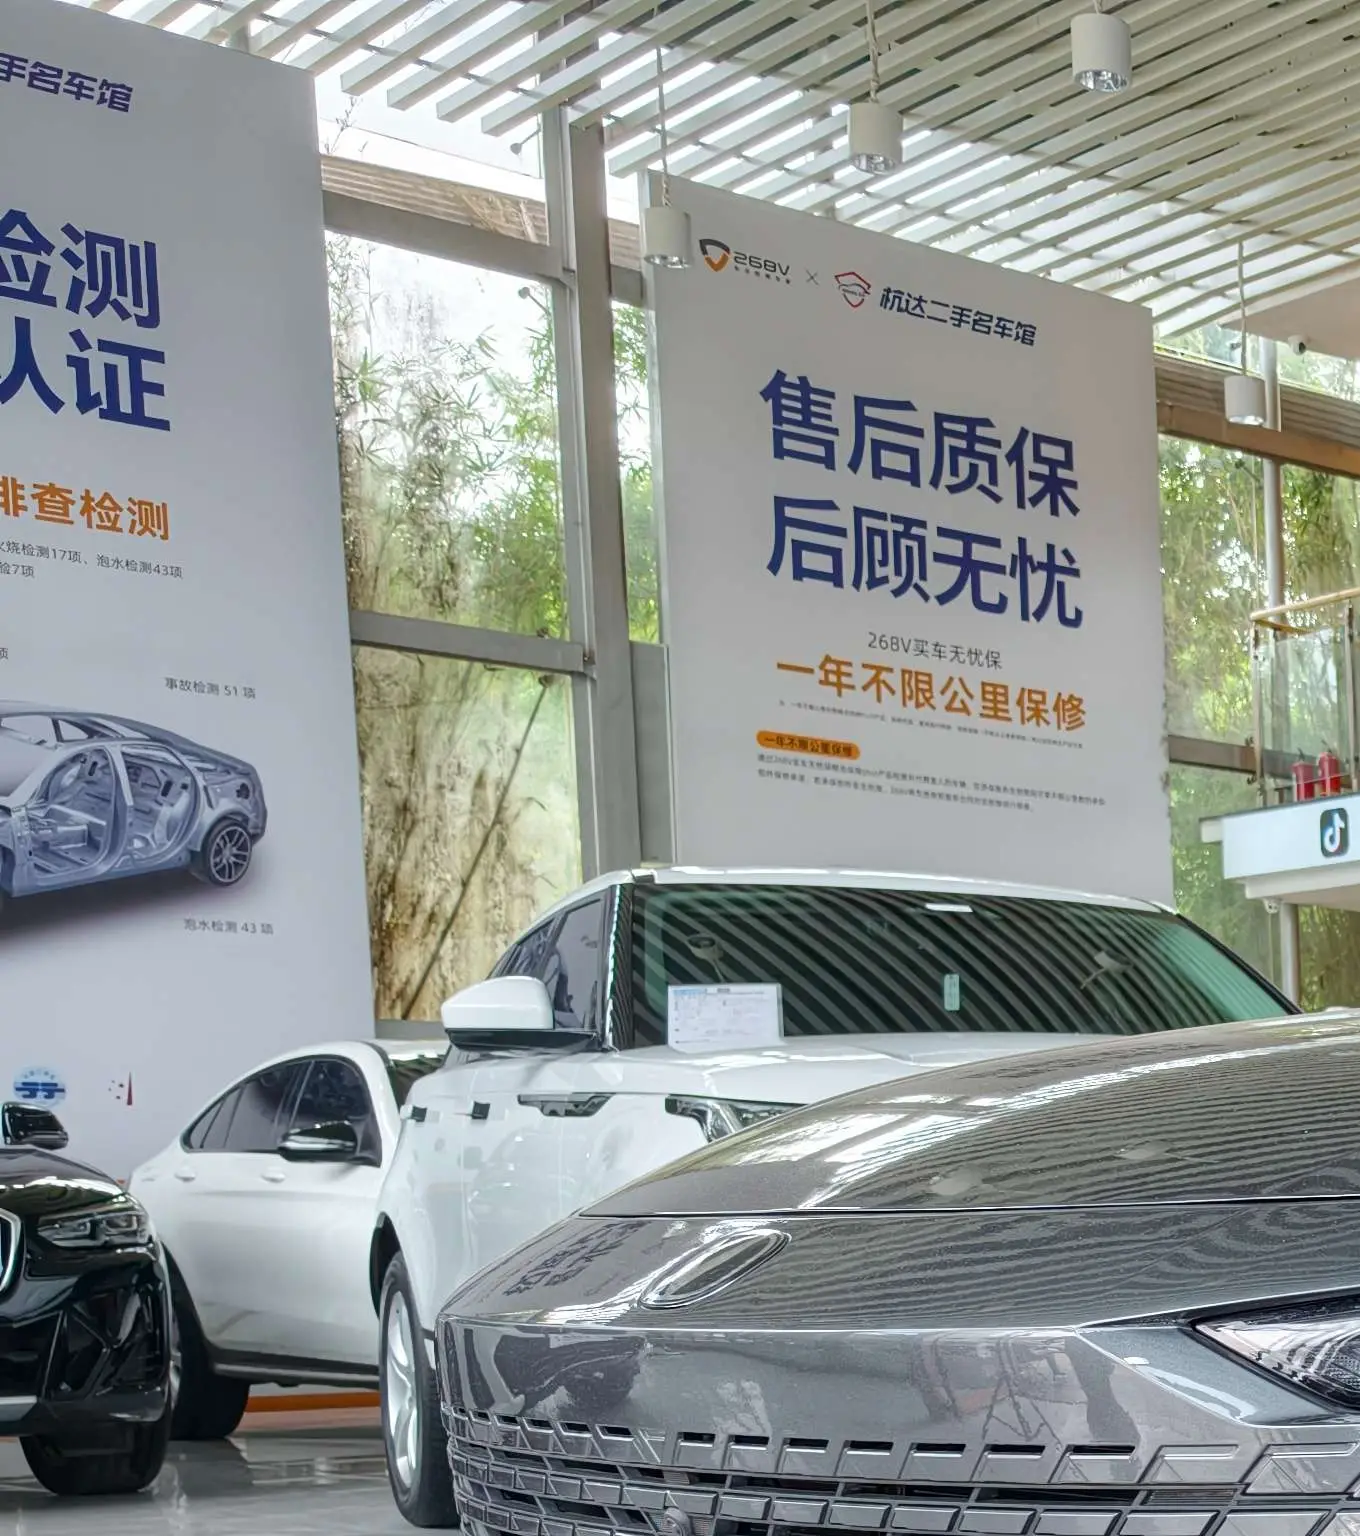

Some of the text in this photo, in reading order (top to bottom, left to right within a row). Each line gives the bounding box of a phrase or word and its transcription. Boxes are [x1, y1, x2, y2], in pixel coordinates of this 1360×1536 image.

[734, 251, 790, 276] 268V
[879, 286, 1037, 347] 杭达二手名车馆
[759, 369, 1081, 517] 售后质保
[766, 495, 1083, 629] 后顾无忧
[868, 631, 1004, 670] 268V买车无忧保
[776, 654, 1088, 732] 一年不限公里保修
